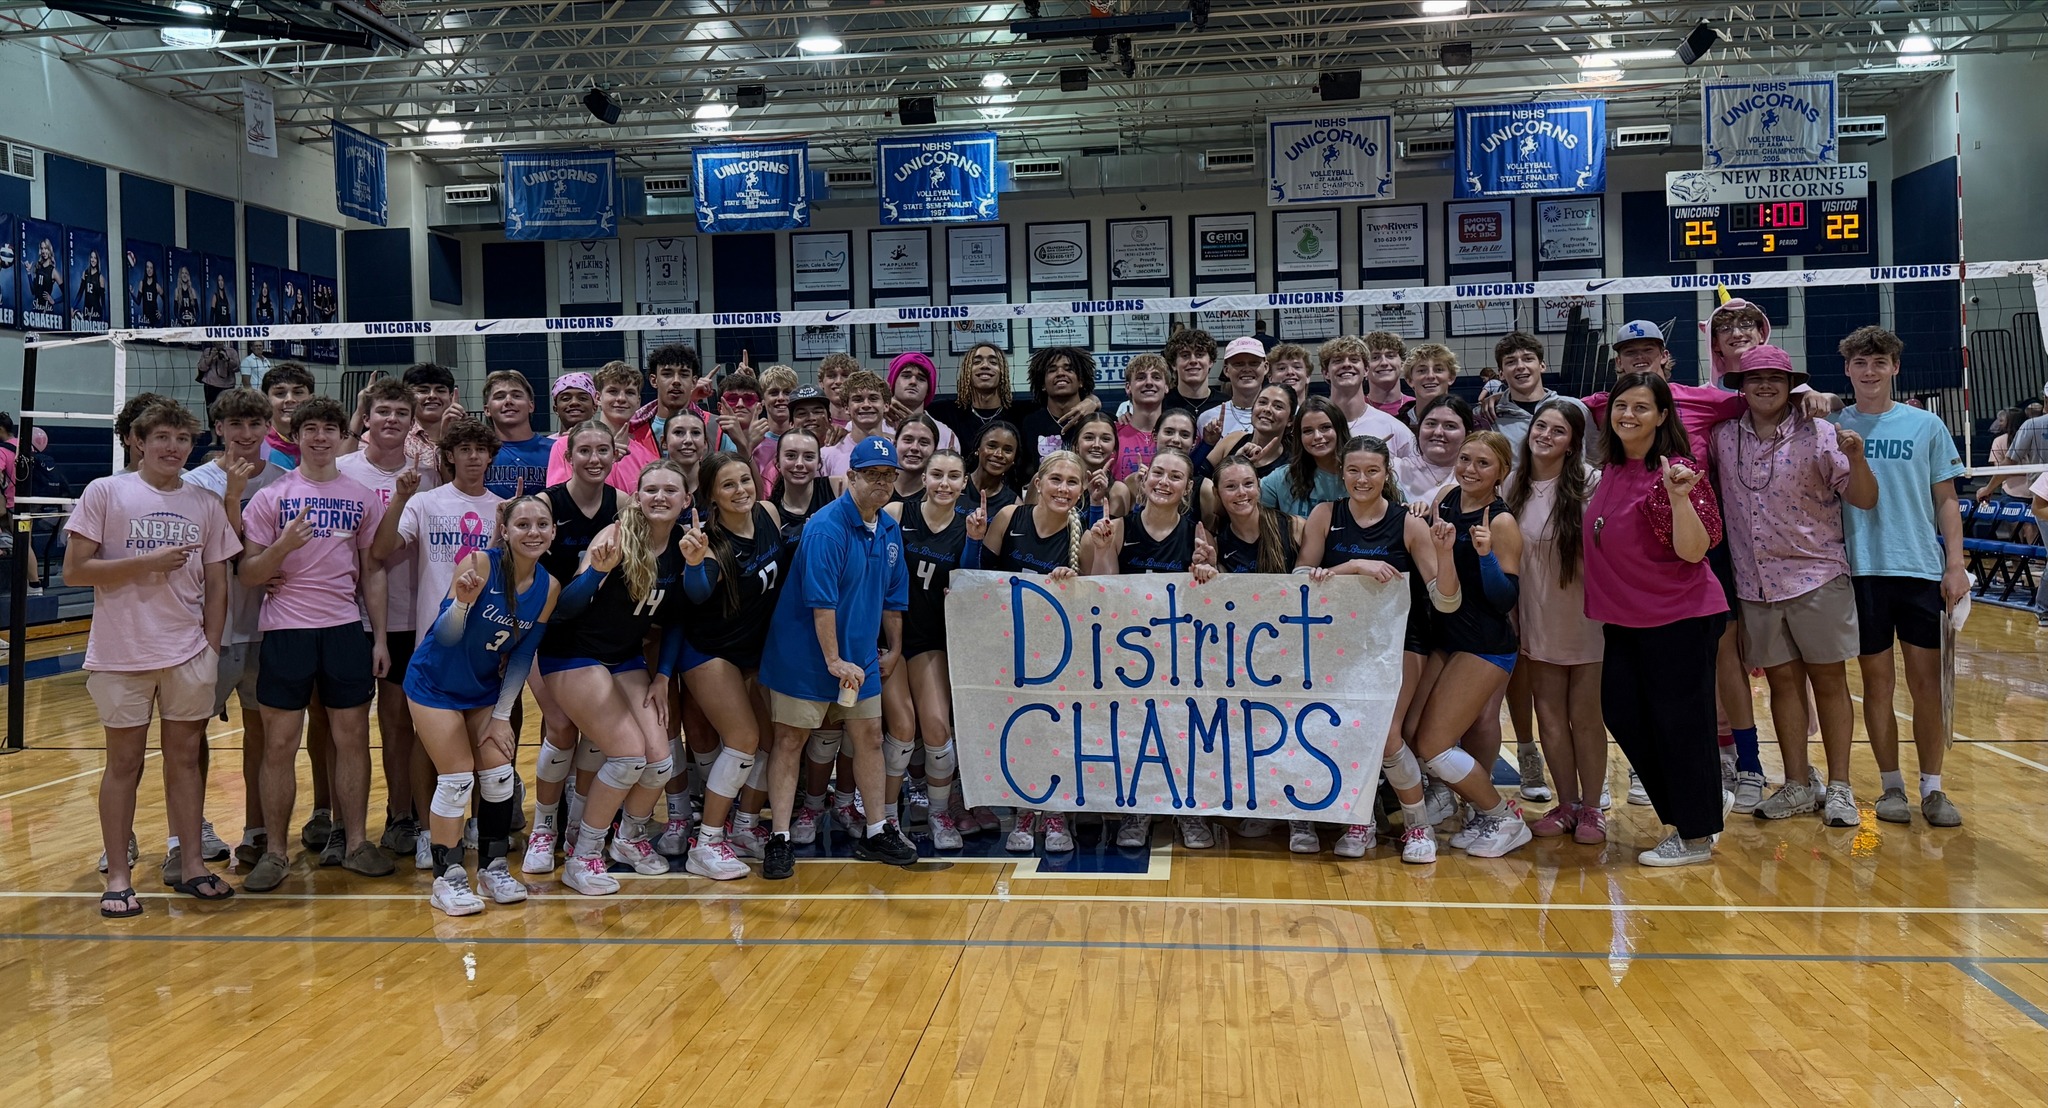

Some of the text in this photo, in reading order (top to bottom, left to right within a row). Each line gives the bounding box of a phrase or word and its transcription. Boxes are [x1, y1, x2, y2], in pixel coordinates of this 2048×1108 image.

[1752, 82, 1787, 93] NBHS
[1512, 109, 1545, 119] NBHS
[1720, 93, 1820, 127] UNICORNS
[1314, 117, 1347, 128] NBHS
[1481, 120, 1578, 153] UNICORNS
[1747, 135, 1795, 144] VOLLEYBALL
[922, 142, 952, 151] NBHS
[1284, 128, 1379, 162] UNICORNS
[1735, 147, 1806, 156] STATE CHAMPIONS
[740, 150, 760, 159] NBHS
[713, 160, 790, 180] UNICORNS
[894, 151, 982, 182] UNICORNS
[1506, 162, 1553, 170] VOLLEYBALL
[522, 168, 598, 186] UNICORNS
[1310, 169, 1354, 178] VOLLEYBALL
[1500, 173, 1559, 183] STATE FINALIST
[1721, 165, 1868, 185] NEW BRAUNFELS
[916, 189, 960, 197] VOLLEYBALL
[1298, 181, 1364, 191] STATE CHAMPIONS
[1744, 182, 1845, 200] UNICORNS
[1564, 207, 1596, 219] Frost
[1674, 206, 1720, 219] UNICORNS
[1821, 200, 1858, 213] VISITOR
[1758, 202, 1804, 228] 1:00
[1291, 223, 1324, 235] Superior Signs
[1463, 223, 1497, 233] MO'S
[1685, 220, 1717, 246] 25
[1826, 213, 1859, 240] 22
[1762, 233, 1775, 252] 3
[575, 260, 603, 270] WILKINS
[654, 255, 679, 263] HITTLE
[662, 262, 671, 279] 3
[1870, 265, 1951, 279] UNICORNS
[1671, 273, 1751, 288] UNICORNS
[1456, 283, 1535, 297] UNICORNS
[1268, 291, 1344, 305] UNICORNS
[1545, 300, 1596, 309] SMOOTHIE
[221, 305, 227, 316] 15
[656, 306, 692, 315] Kyle Hittle
[898, 306, 969, 319] UNICORNS
[1071, 299, 1144, 313] UNICORNS
[23, 310, 63, 330] SCHAEFER
[712, 312, 781, 325] UNICORNS
[1203, 310, 1250, 319] VALMARK
[1557, 309, 1570, 319] Ki
[364, 322, 432, 334] UNICORNS
[545, 317, 614, 329] UNICORNS
[205, 327, 270, 338] UNICORNS
[873, 439, 889, 457] NB
[1864, 438, 1914, 461] ENDS
[484, 464, 548, 483] UNICORN
[279, 497, 364, 513] NEW BRAUNFELS
[279, 509, 363, 531] UNCORNS
[129, 518, 200, 543] NBHS
[429, 531, 492, 546] UNICOR
[1022, 553, 1060, 570] Braunfel
[758, 560, 778, 594] 17
[916, 559, 937, 590] 4
[633, 589, 665, 616] 14
[1009, 576, 1333, 690] District
[485, 630, 511, 652] 3
[999, 697, 1343, 811] CHAMPS
